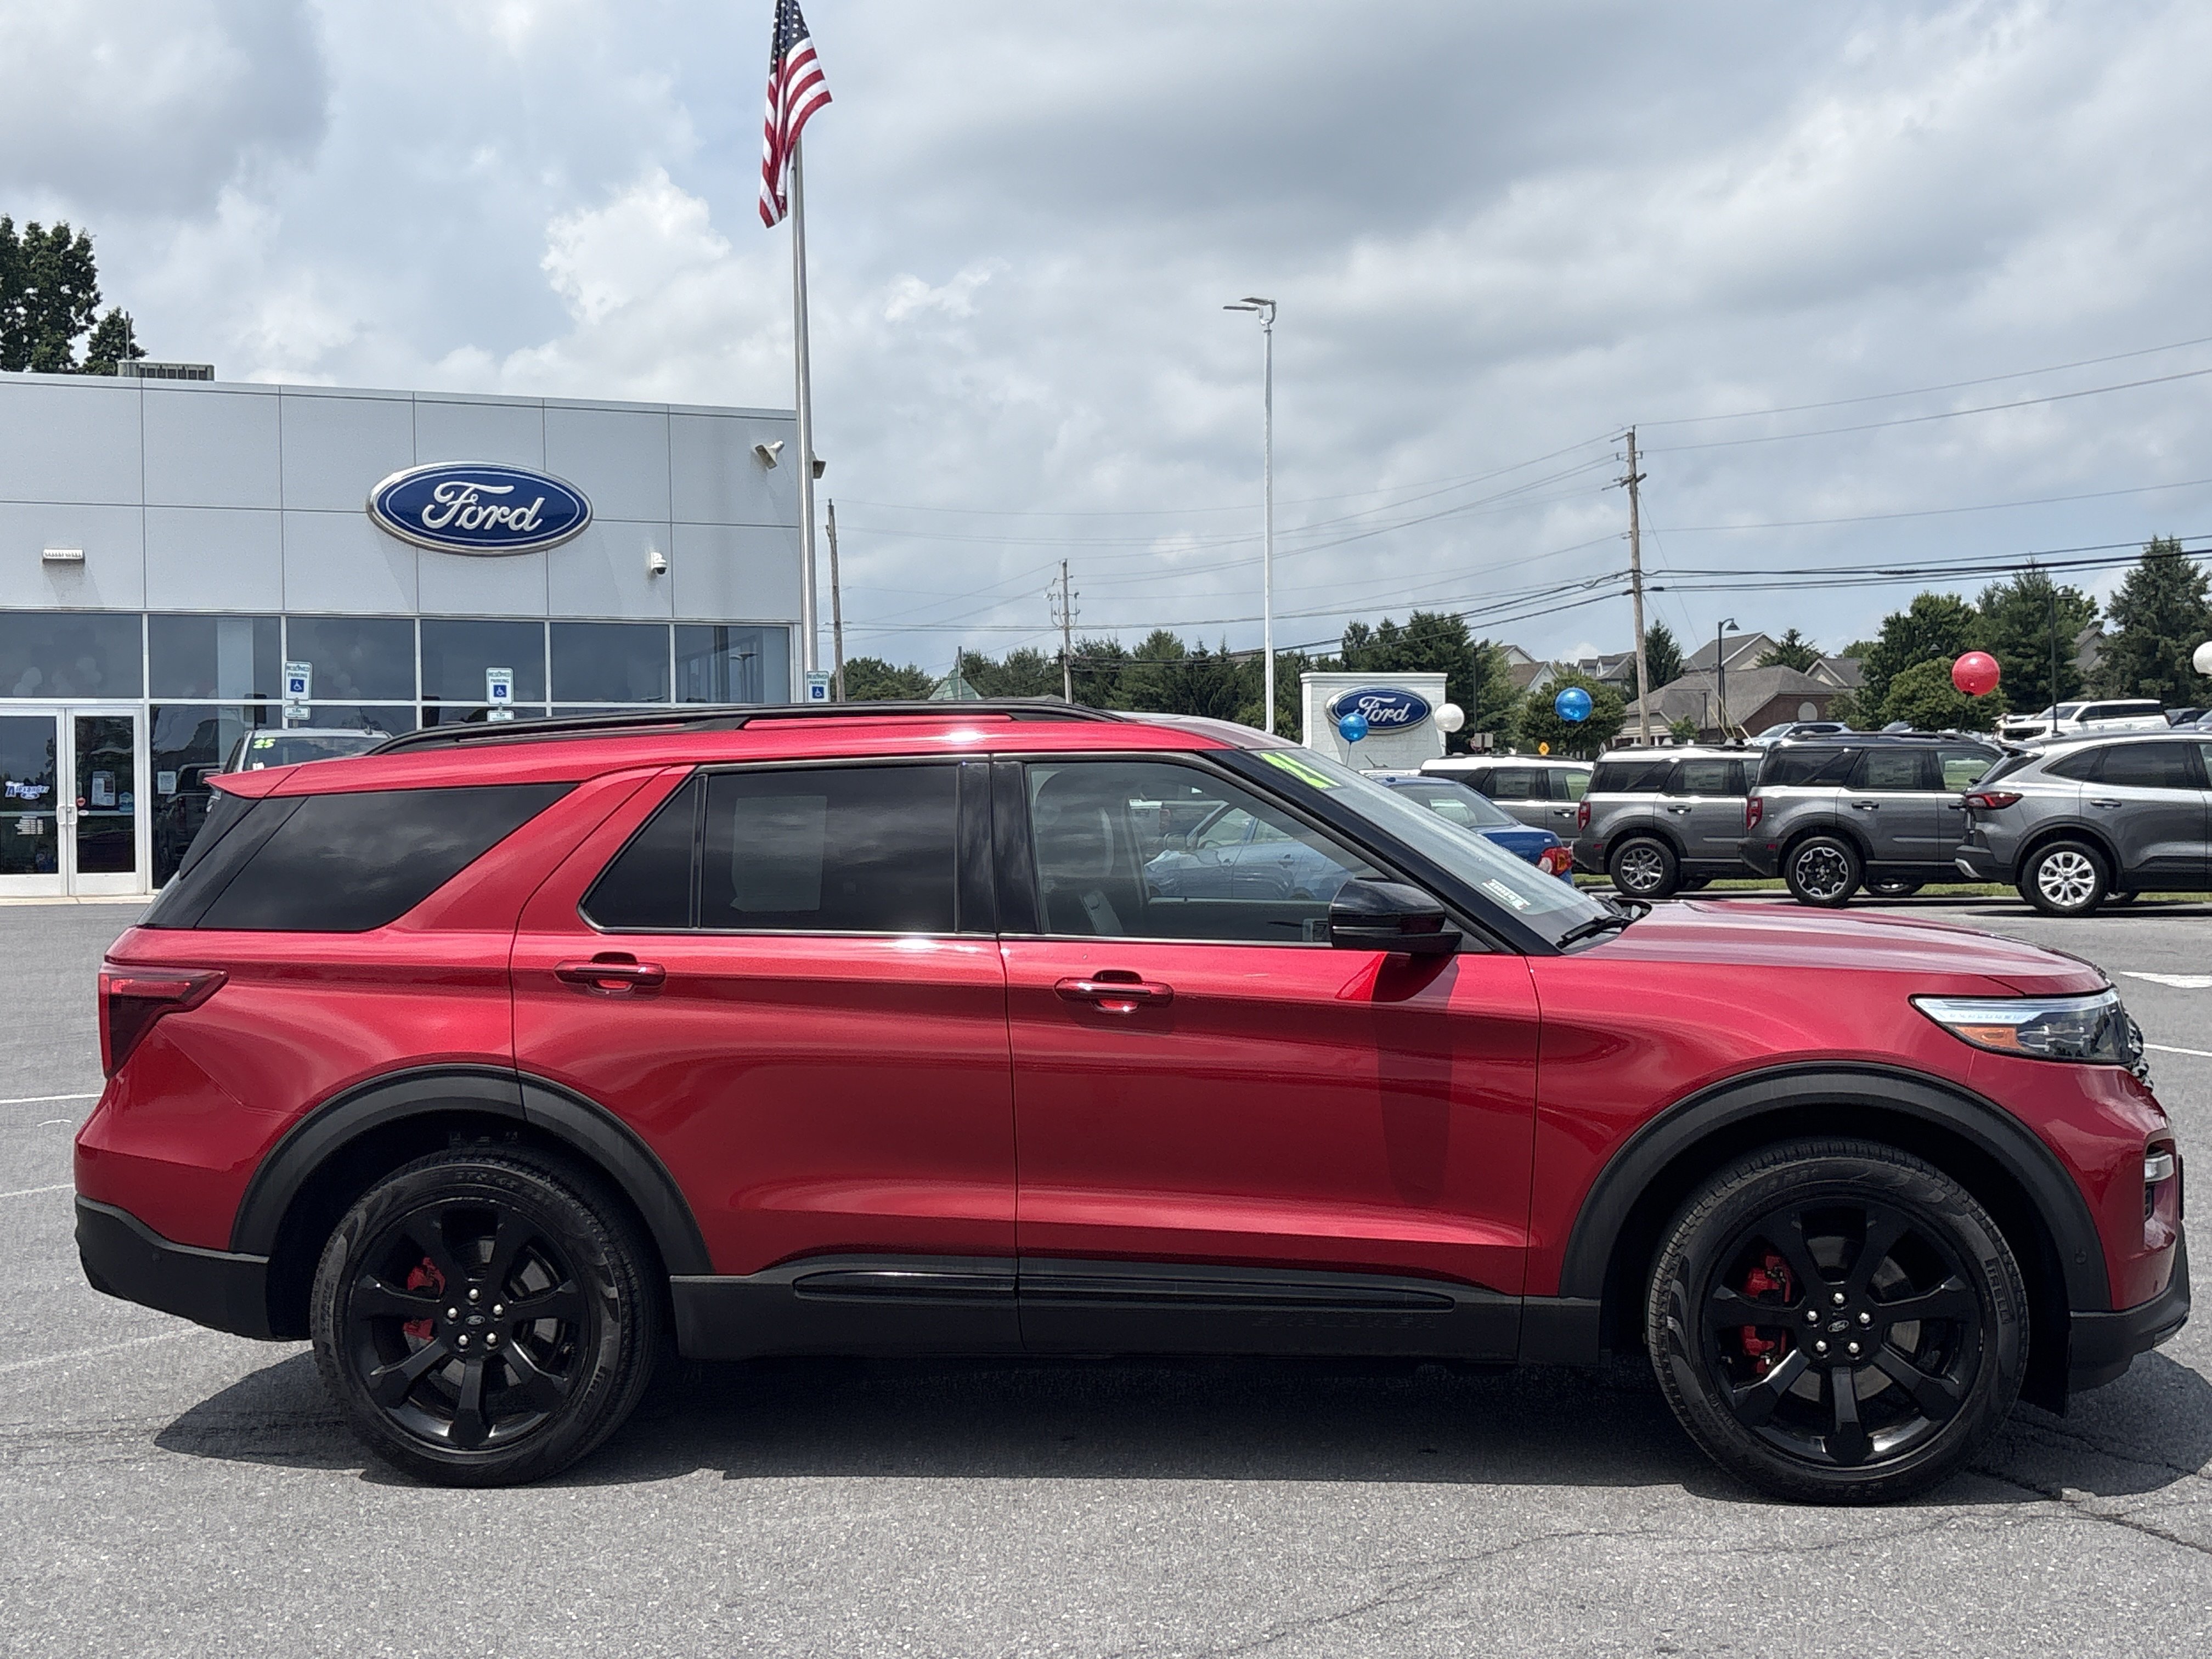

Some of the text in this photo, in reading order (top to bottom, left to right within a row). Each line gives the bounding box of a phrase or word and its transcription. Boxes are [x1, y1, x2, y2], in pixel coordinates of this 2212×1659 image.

[422, 481, 545, 532] Ford
[1353, 696, 1411, 722] Ford
[253, 738, 275, 749] 25
